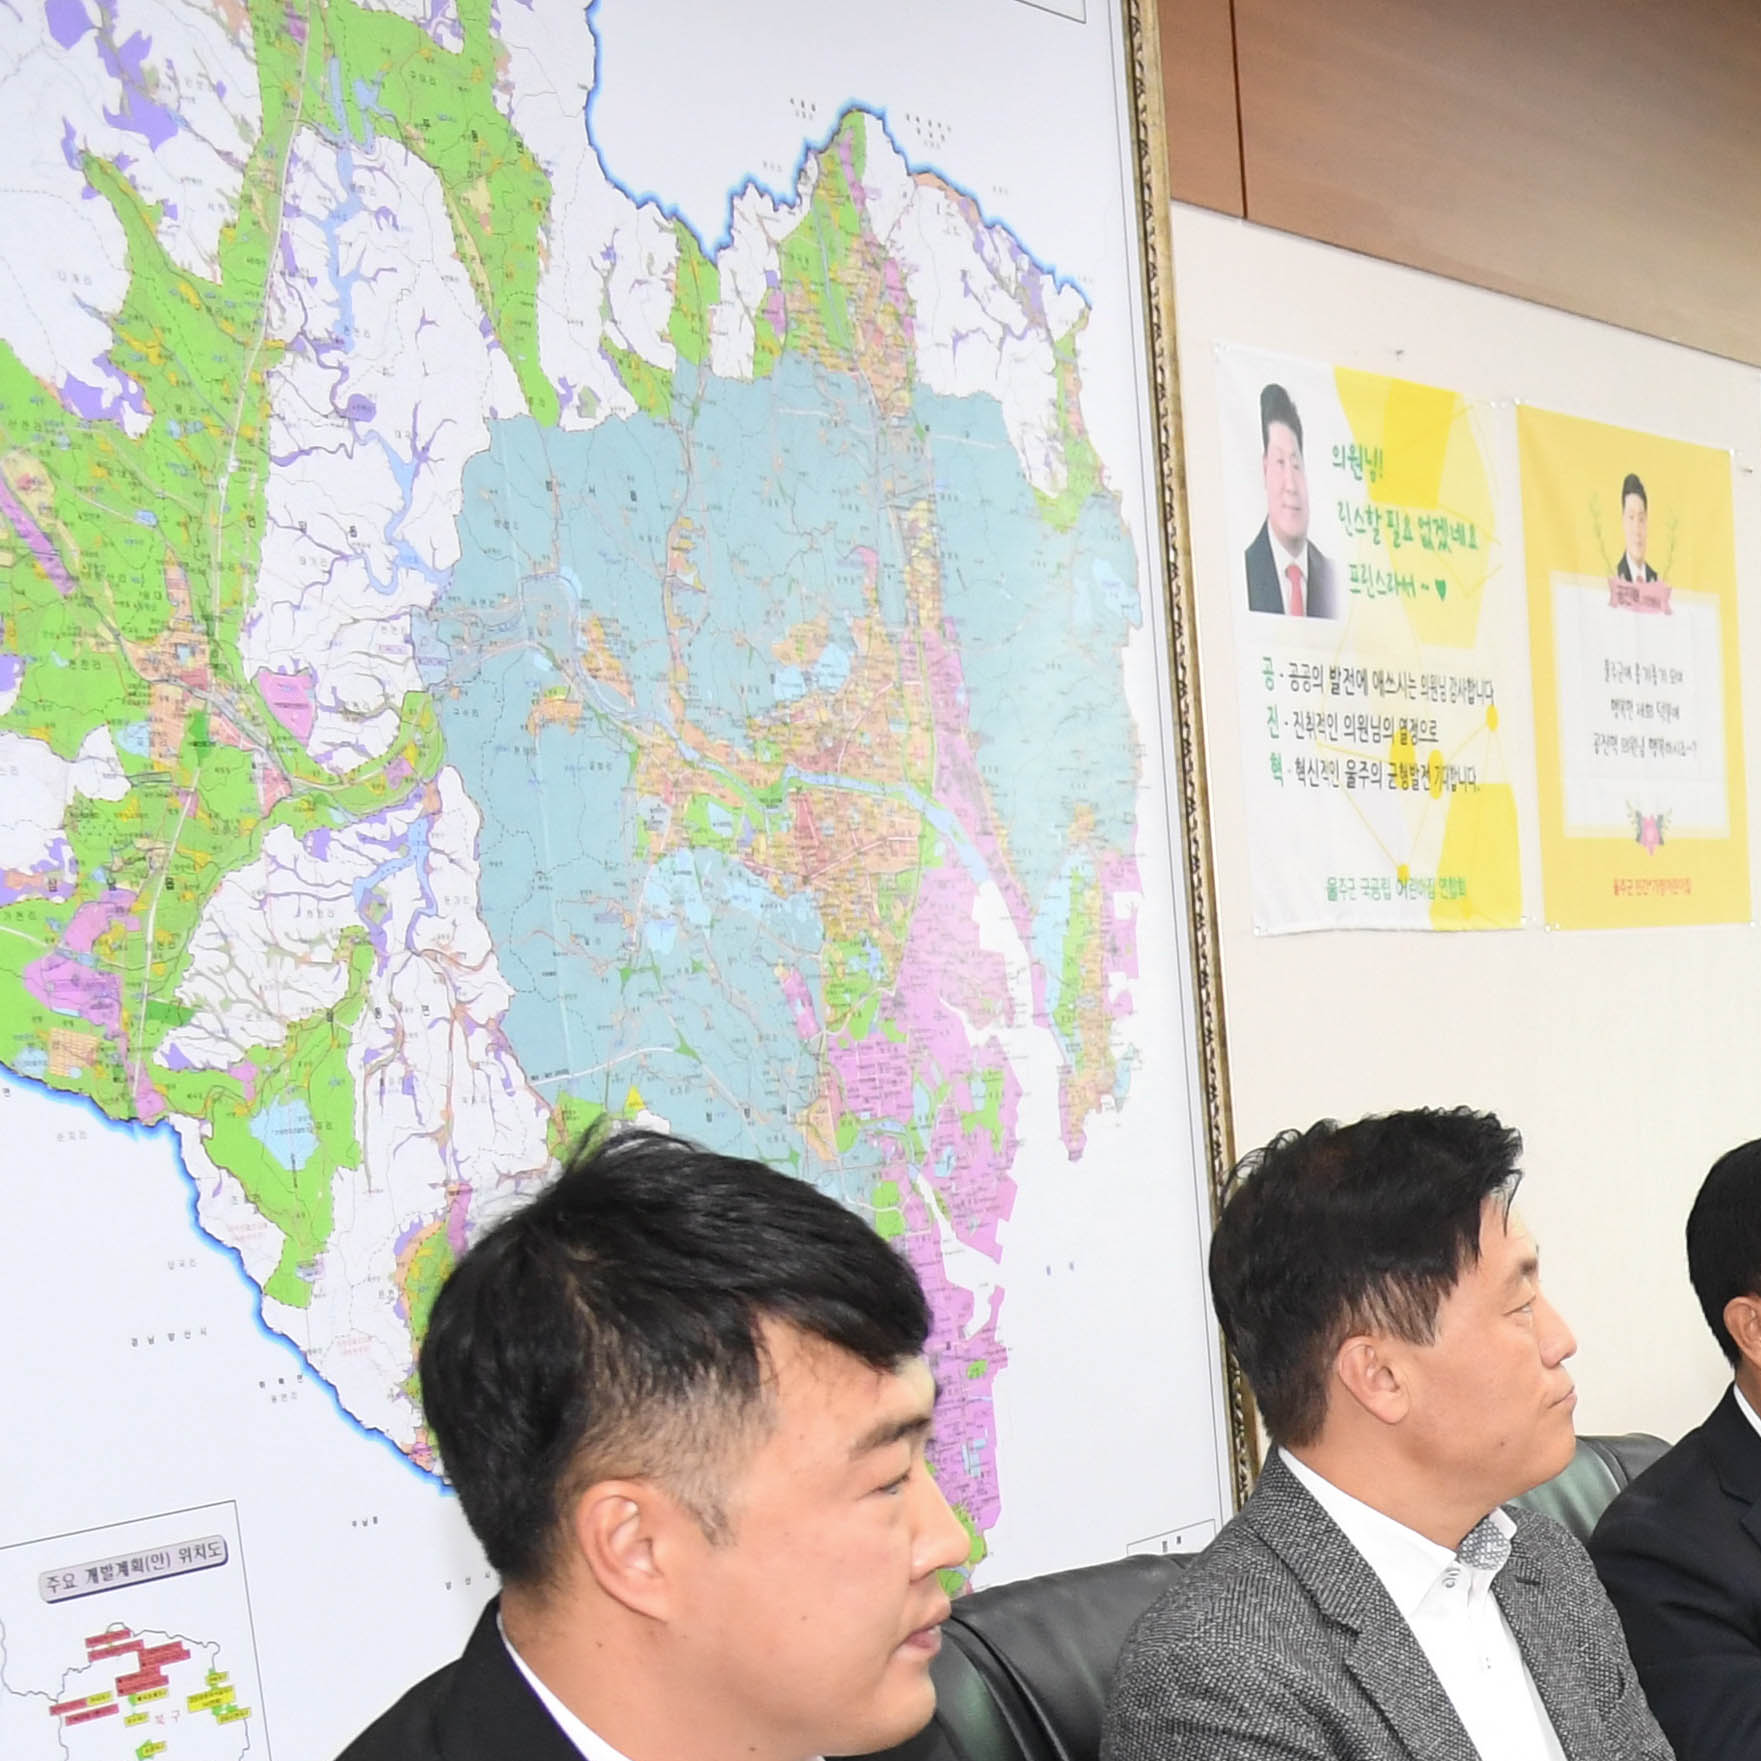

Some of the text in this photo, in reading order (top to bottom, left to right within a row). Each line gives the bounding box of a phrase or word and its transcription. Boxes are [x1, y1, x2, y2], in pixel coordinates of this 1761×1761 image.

[1332, 443, 1384, 483] 의원님!
[1337, 501, 1479, 554] 린스할 필요 없겠네요
[1288, 662, 1324, 694] 공공의
[1328, 664, 1369, 697] 발전에
[1420, 673, 1448, 702] 의원님
[1343, 714, 1394, 743] 의원님의
[1344, 759, 1383, 789] 울주의
[47, 1541, 222, 1594] 주요 개발계획(안) 위치도
